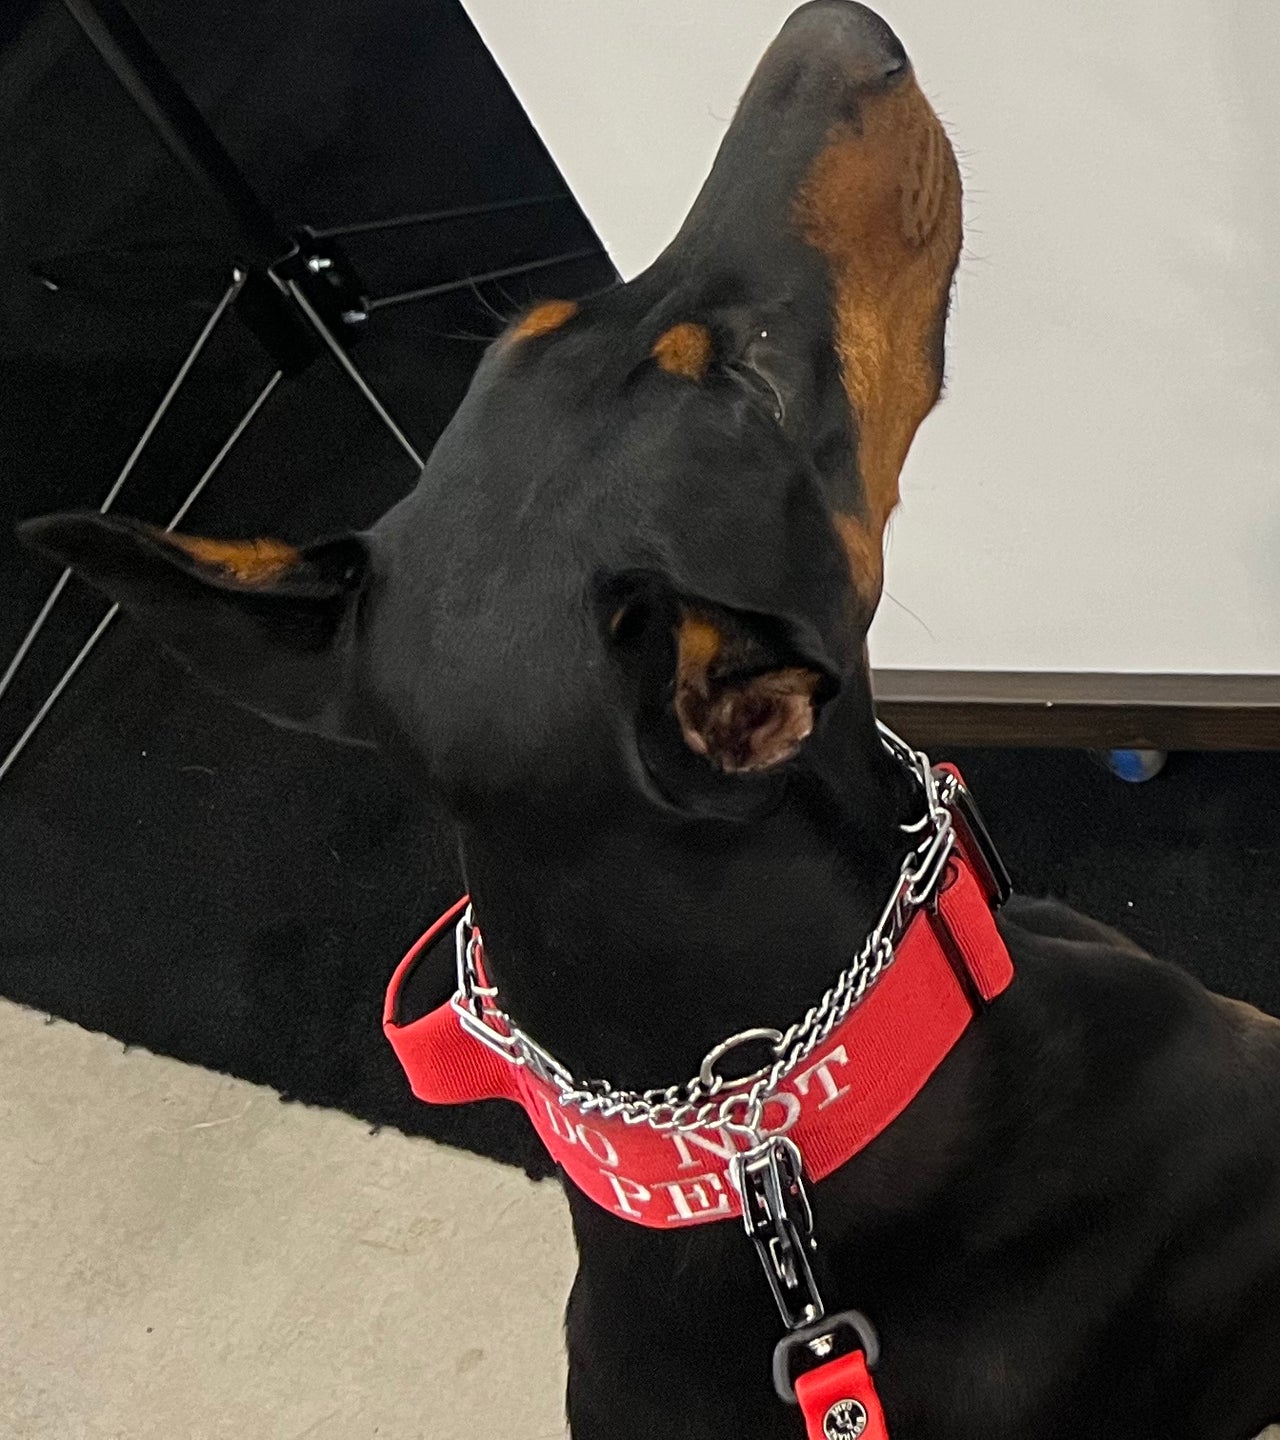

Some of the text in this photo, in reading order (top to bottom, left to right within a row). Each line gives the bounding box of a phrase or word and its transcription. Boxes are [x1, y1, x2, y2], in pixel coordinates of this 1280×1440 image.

[537, 1044, 851, 1170] DO NOT
[599, 1168, 743, 1222] PE
